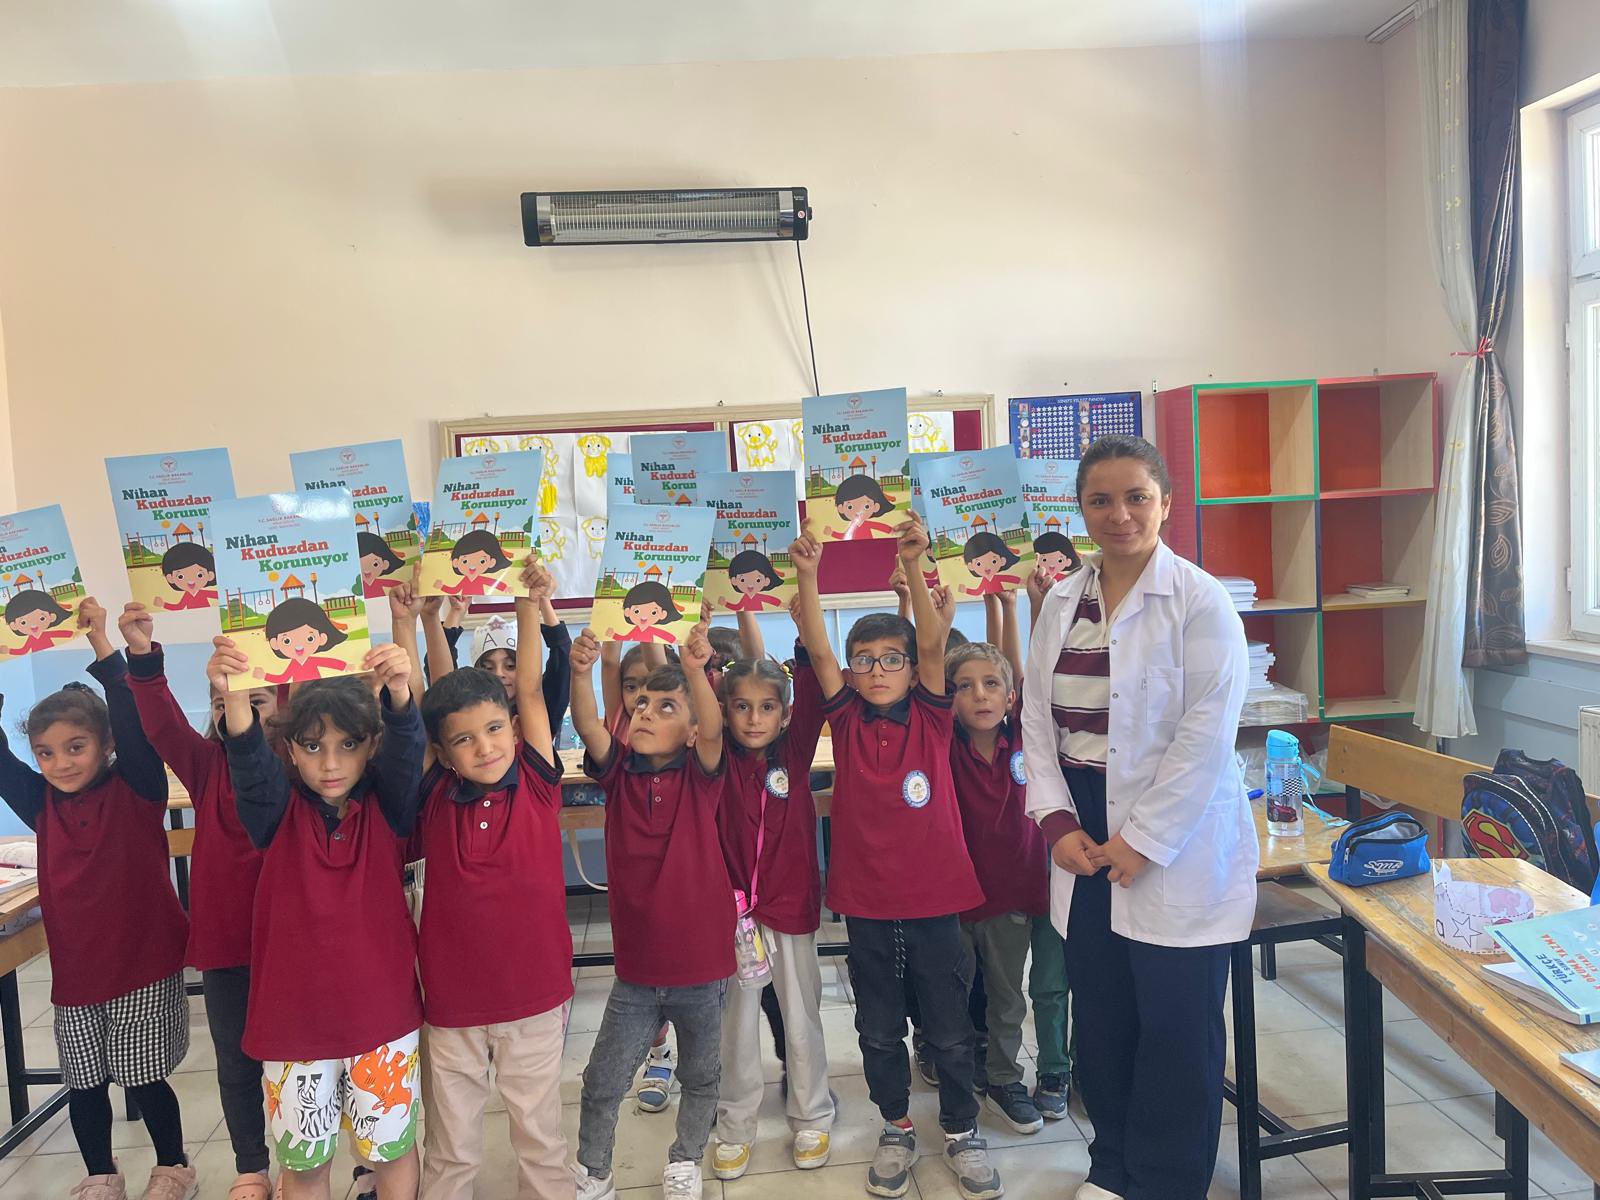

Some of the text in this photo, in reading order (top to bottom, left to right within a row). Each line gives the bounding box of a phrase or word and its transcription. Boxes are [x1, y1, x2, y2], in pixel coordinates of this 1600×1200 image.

[812, 423, 850, 434] Nihan
[822, 429, 887, 444] Kuduzdan
[834, 440, 901, 454] Korunuyor
[641, 462, 676, 471] Nihan
[650, 470, 696, 480] Kuduzd
[304, 480, 347, 491] Nihan
[443, 482, 480, 493] Nihan
[615, 477, 634, 486] Nih
[662, 481, 696, 490] Korun
[122, 488, 168, 500] Nihan
[352, 485, 388, 497] zdan
[450, 488, 515, 501] Kuduzdan
[930, 485, 967, 498] Nihan
[1021, 484, 1047, 493] ihan
[136, 495, 212, 510] Kuduzdan
[353, 495, 404, 509] runuyor
[942, 488, 1003, 506] Kuduzdan
[460, 498, 528, 510] Korunuyor
[706, 500, 743, 509] Nihan
[955, 495, 1017, 514] Korunuyor
[1032, 503, 1080, 514] Korunuy
[152, 508, 209, 520] Korunu
[716, 508, 777, 519] Kuduzdan
[728, 520, 791, 530] Korunuyor
[225, 534, 279, 550] Nihan
[614, 532, 654, 541] Nihan
[240, 540, 329, 561] Kuduzdan
[623, 541, 689, 552] Kuduzdan
[0, 545, 49, 563] duzdan
[633, 552, 702, 564] Korunuyor
[258, 552, 349, 572] Korunuyor
[1542, 933, 1596, 982] OKUMA YAZMA
[1536, 953, 1572, 984] TÜRKÇE
[1553, 958, 1570, 971] SINIF
